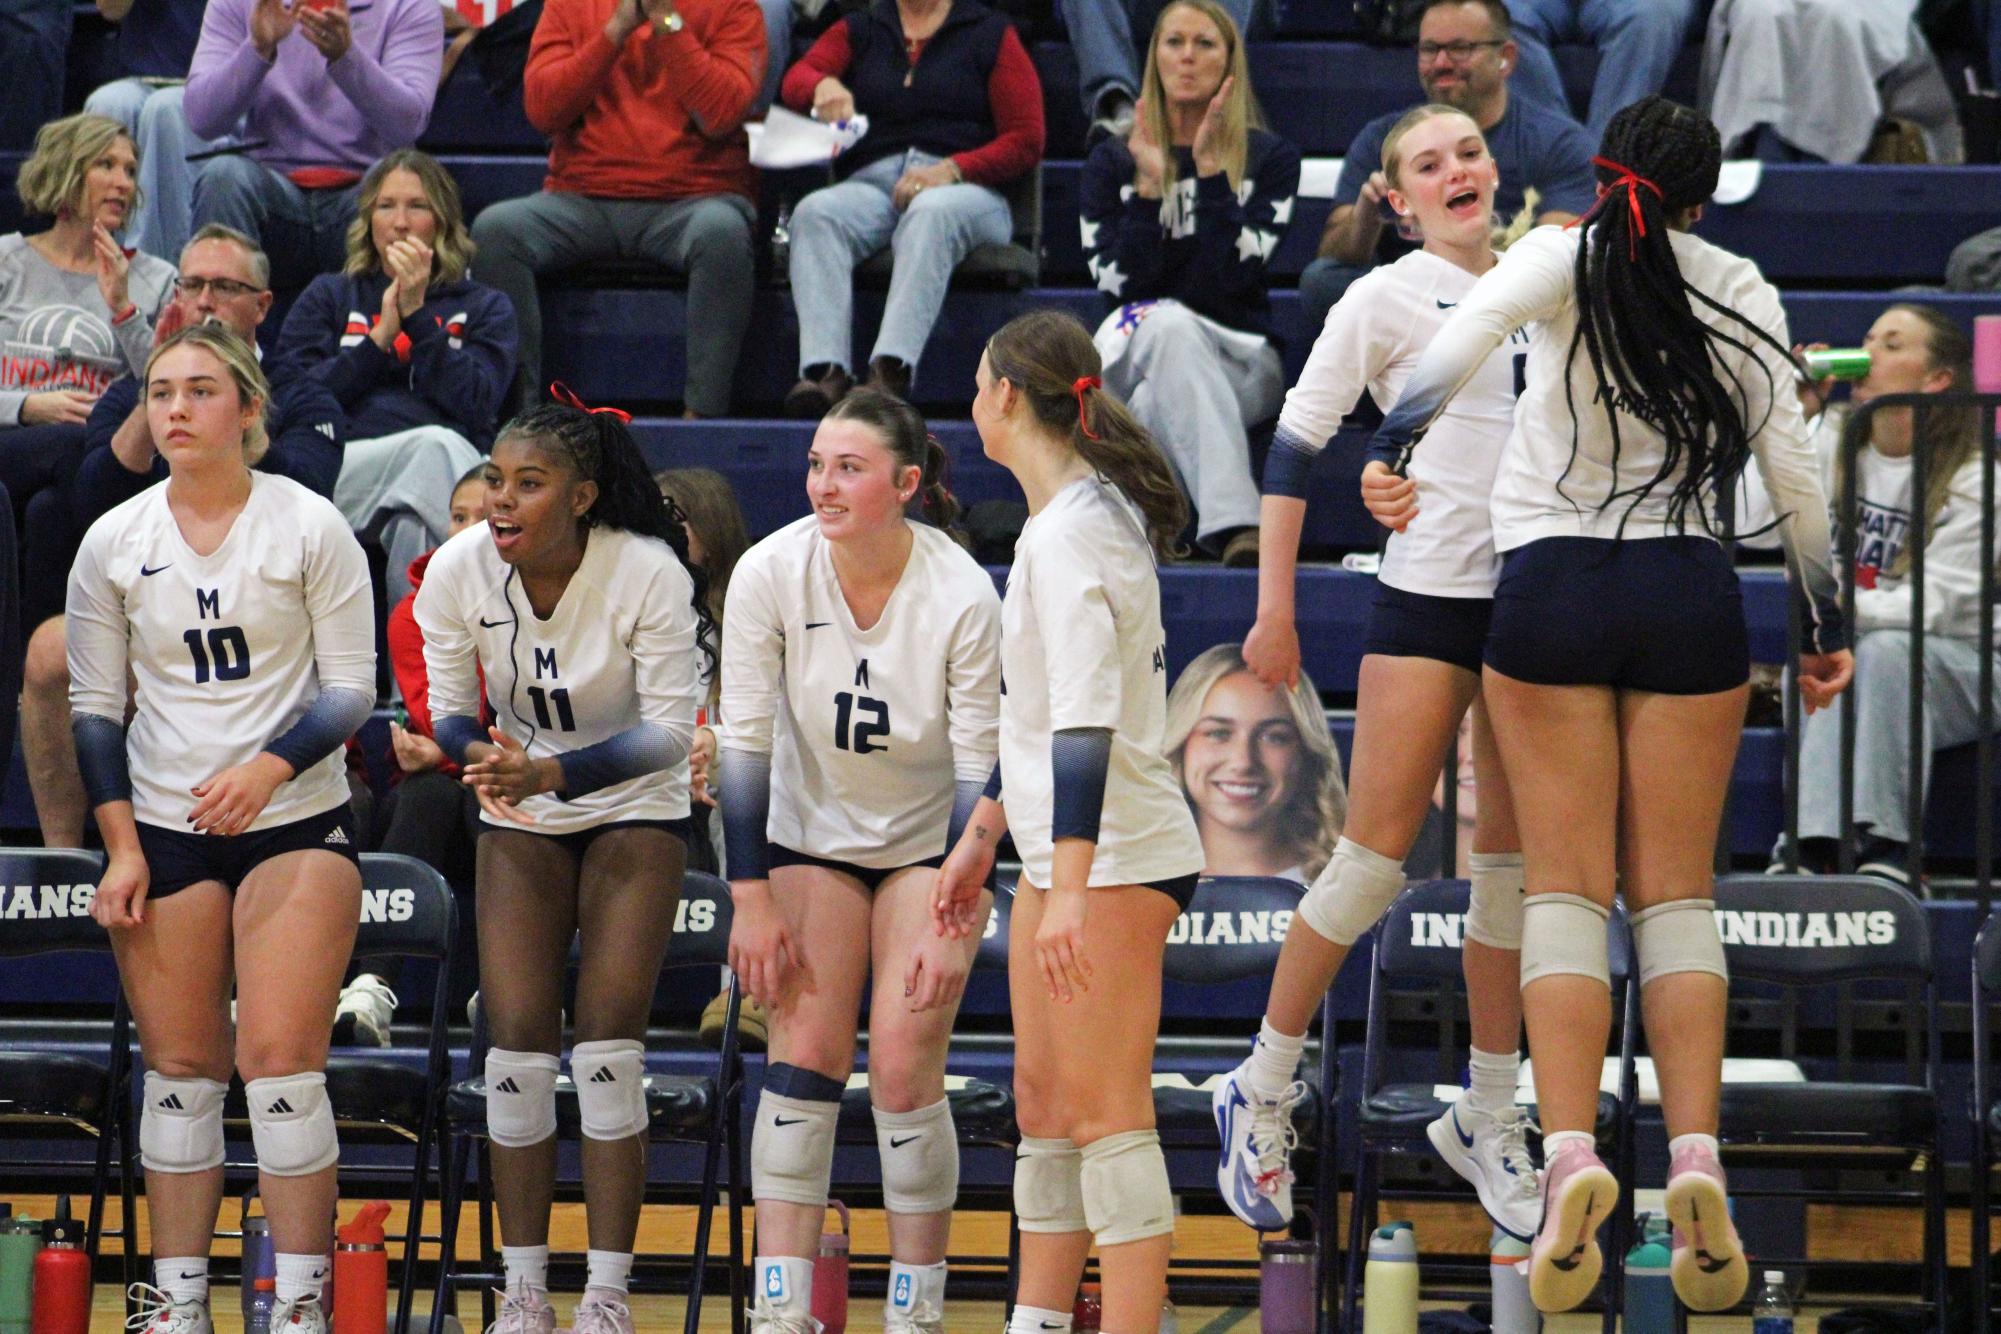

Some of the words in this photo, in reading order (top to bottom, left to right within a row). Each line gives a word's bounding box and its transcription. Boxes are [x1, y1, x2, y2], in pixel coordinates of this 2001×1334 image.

[196, 588, 221, 620] M
[183, 626, 251, 684] 10
[534, 647, 558, 680] M
[527, 685, 576, 732] 11
[834, 691, 891, 754] 12
[1410, 912, 1468, 947] IN
[1712, 909, 1896, 948] INDIANS
